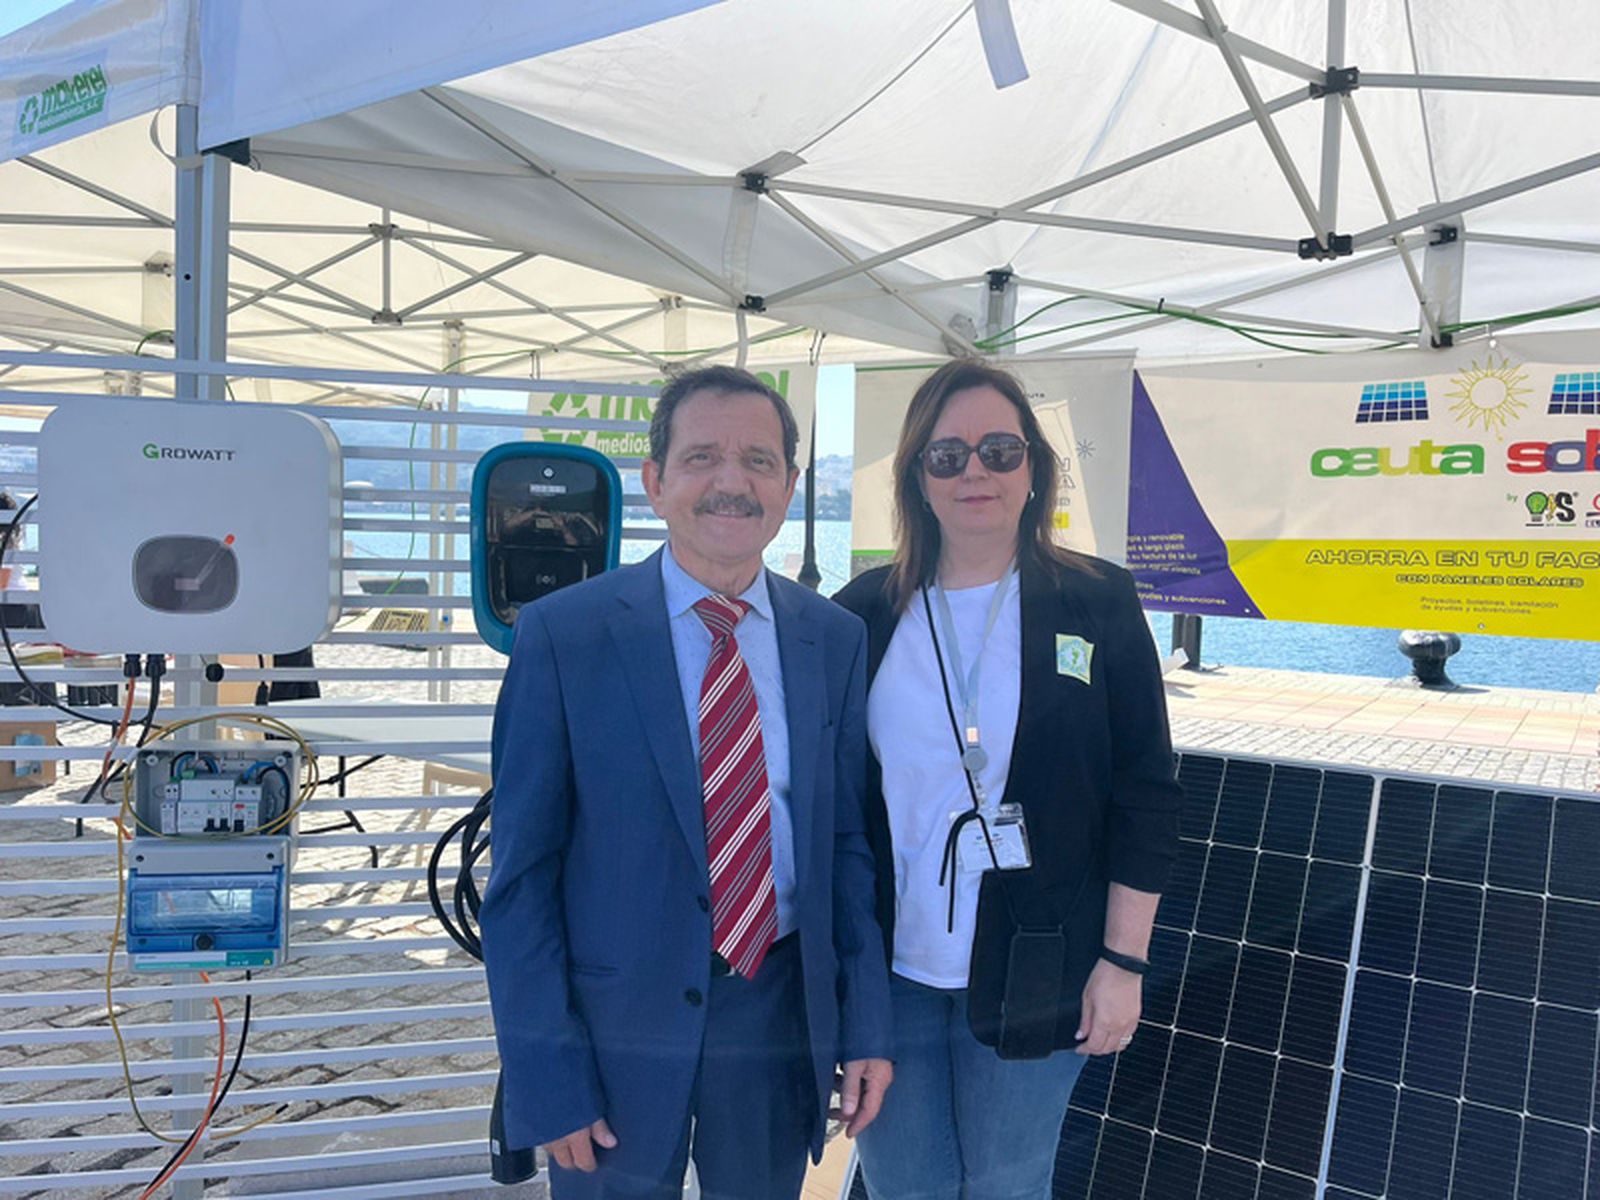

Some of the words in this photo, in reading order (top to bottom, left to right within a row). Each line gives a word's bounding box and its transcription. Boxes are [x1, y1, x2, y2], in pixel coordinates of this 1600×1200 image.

[142, 443, 236, 461] GROWATT
[1310, 439, 1486, 477] ceuta
[1506, 428, 1600, 474] sol
[1305, 549, 1430, 567] AHORRA
[1436, 550, 1479, 567] EN
[1485, 551, 1529, 568] TU
[1535, 551, 1600, 569] FAC
[1395, 574, 1430, 584] CON
[1432, 574, 1504, 586] PANELES
[1505, 576, 1584, 588] SOLARES
